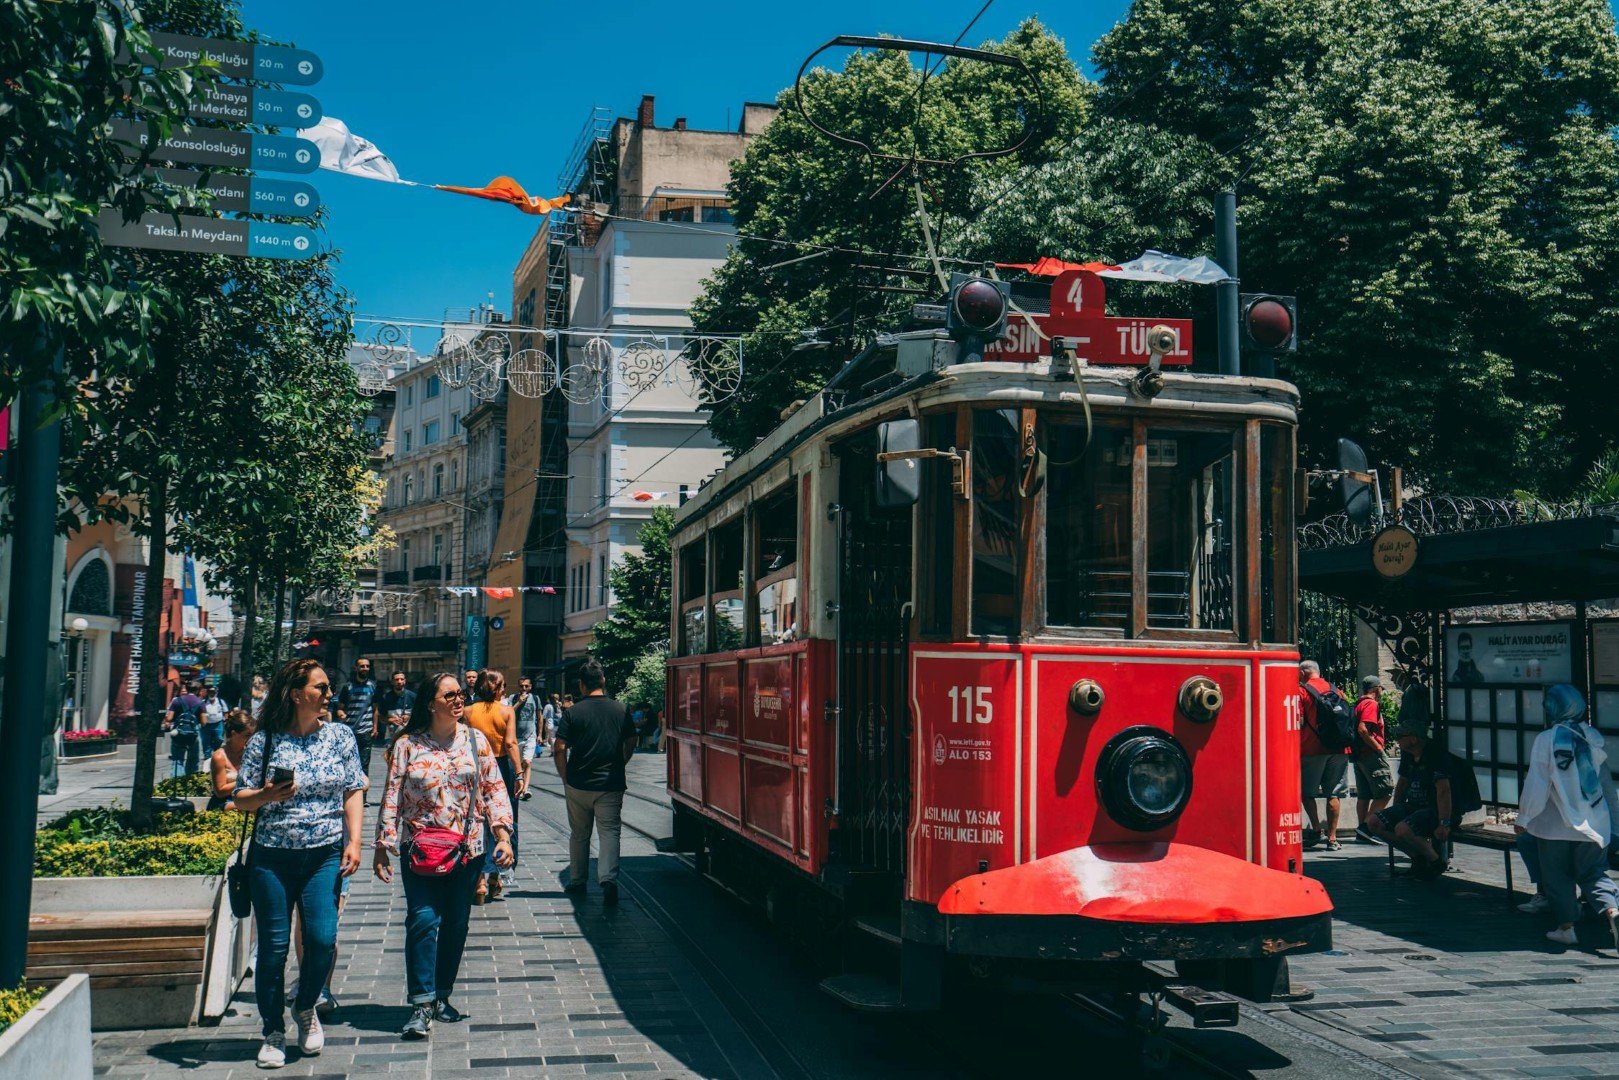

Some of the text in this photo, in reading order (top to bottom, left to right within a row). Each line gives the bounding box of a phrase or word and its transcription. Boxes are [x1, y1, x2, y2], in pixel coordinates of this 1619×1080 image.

[259, 59, 271, 68] 20
[204, 88, 248, 105] Tunaya
[200, 101, 248, 117] Merkezi
[258, 102, 271, 112] 50
[165, 137, 246, 157] Konsolosluğu
[256, 148, 287, 159] 150 m
[255, 191, 286, 202] 560 m
[191, 229, 243, 245] Meydanı
[253, 236, 291, 246] 1440 m
[1067, 277, 1083, 313] 4
[131, 571, 147, 622] TANPINAR
[1488, 632, 1567, 646] HALİT AYAR DURAĞI
[127, 659, 141, 695] AHMET
[948, 685, 993, 724] 115
[949, 750, 992, 761] ALO 153
[924, 806, 1001, 826] ASILMAK YASAK
[921, 823, 1004, 845] VE TEHLİKELİDİR
[1275, 831, 1287, 846] VE
